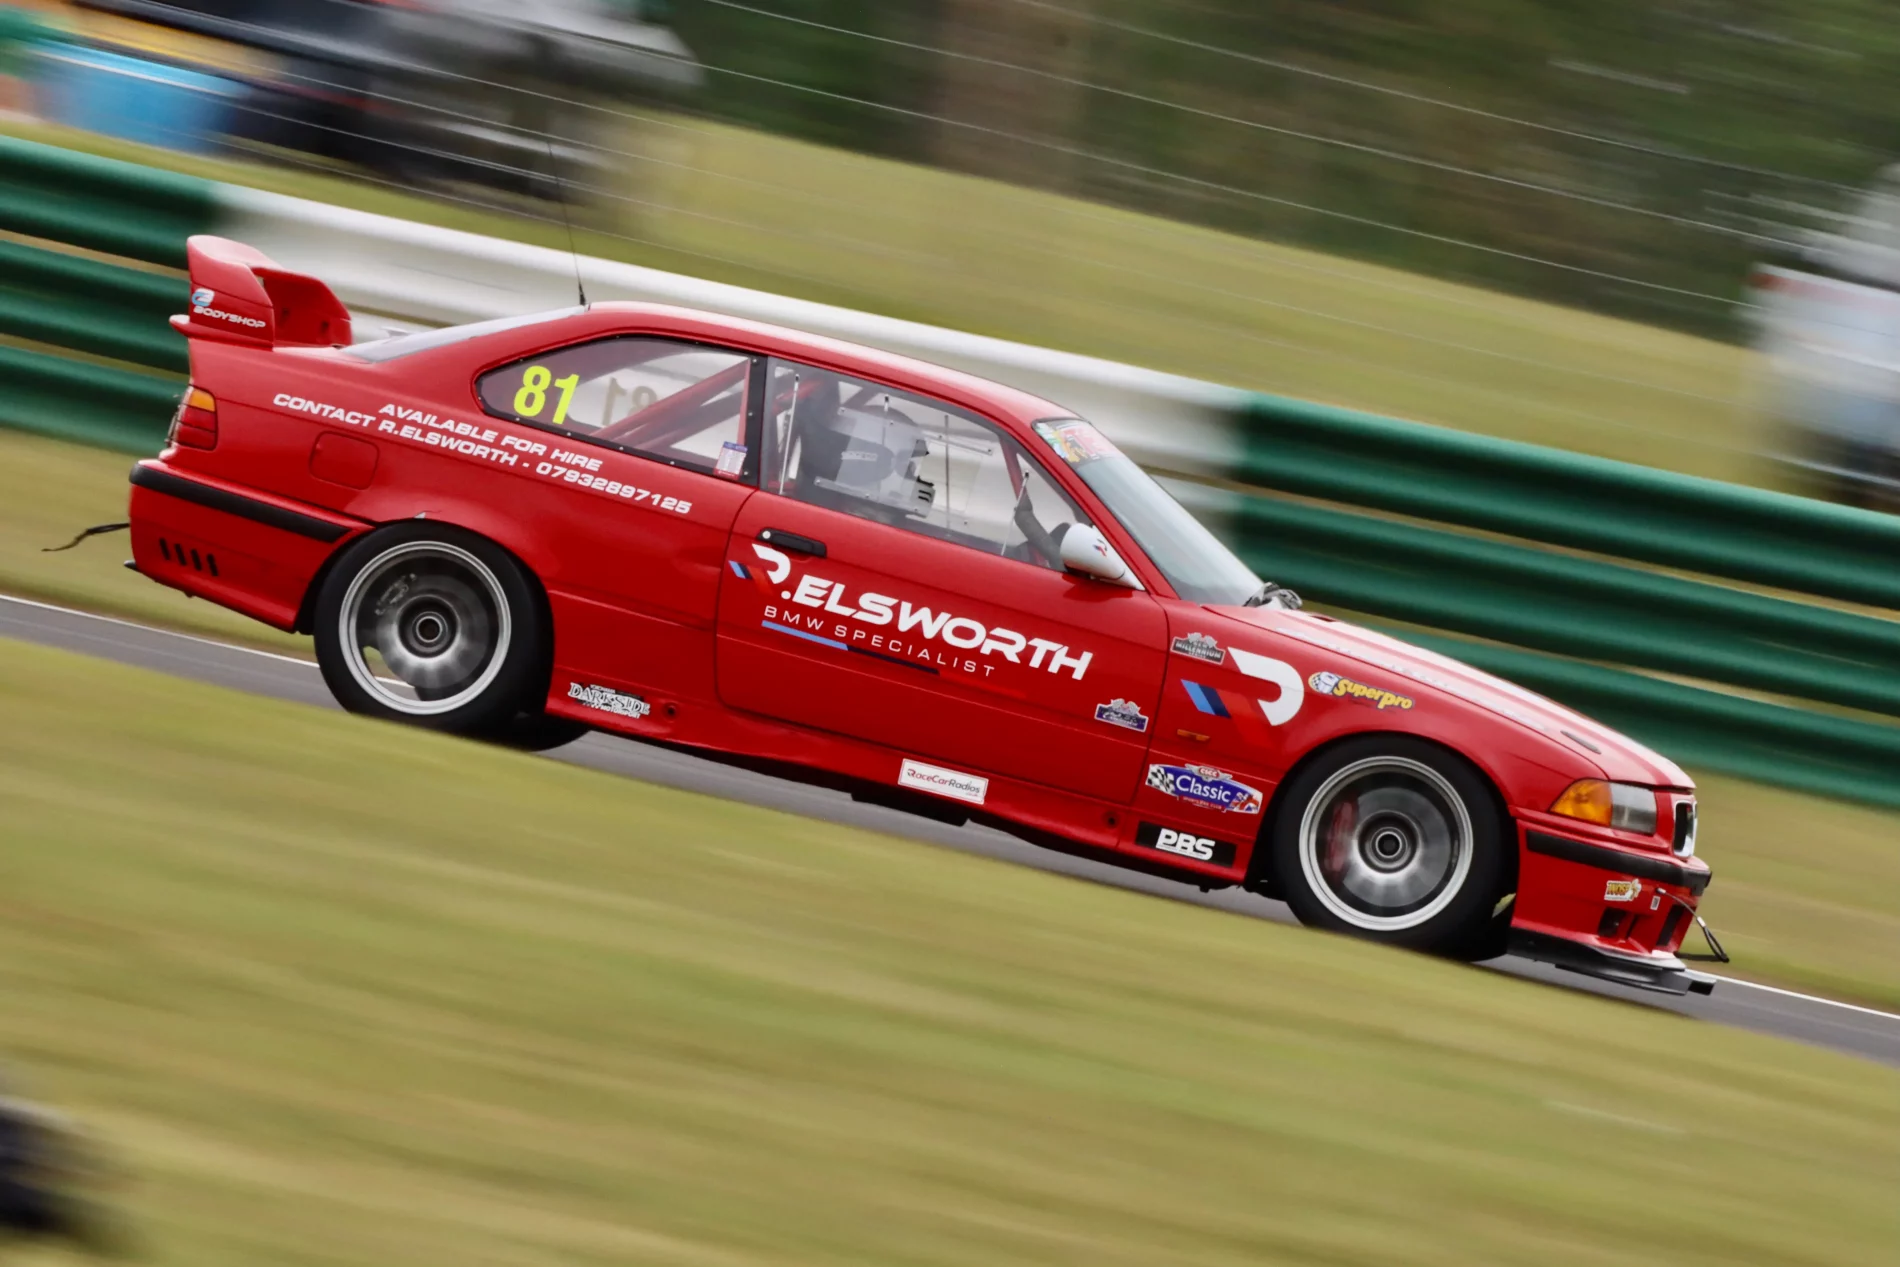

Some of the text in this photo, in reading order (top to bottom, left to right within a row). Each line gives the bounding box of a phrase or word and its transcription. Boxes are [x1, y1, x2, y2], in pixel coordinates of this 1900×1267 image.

[193, 306, 266, 328] BODYSHOP
[513, 365, 580, 425] 81
[273, 393, 376, 427] CONTACT
[378, 420, 519, 466] R.ELSWORTH
[535, 461, 693, 514] 07932897125
[379, 403, 604, 471] AVAILABLE FOR HIRE
[763, 605, 995, 677] BMW SPECIALIST
[907, 768, 980, 793] RaceCarRadios
[1176, 775, 1231, 802] Classic
[1155, 828, 1216, 860] PBS
